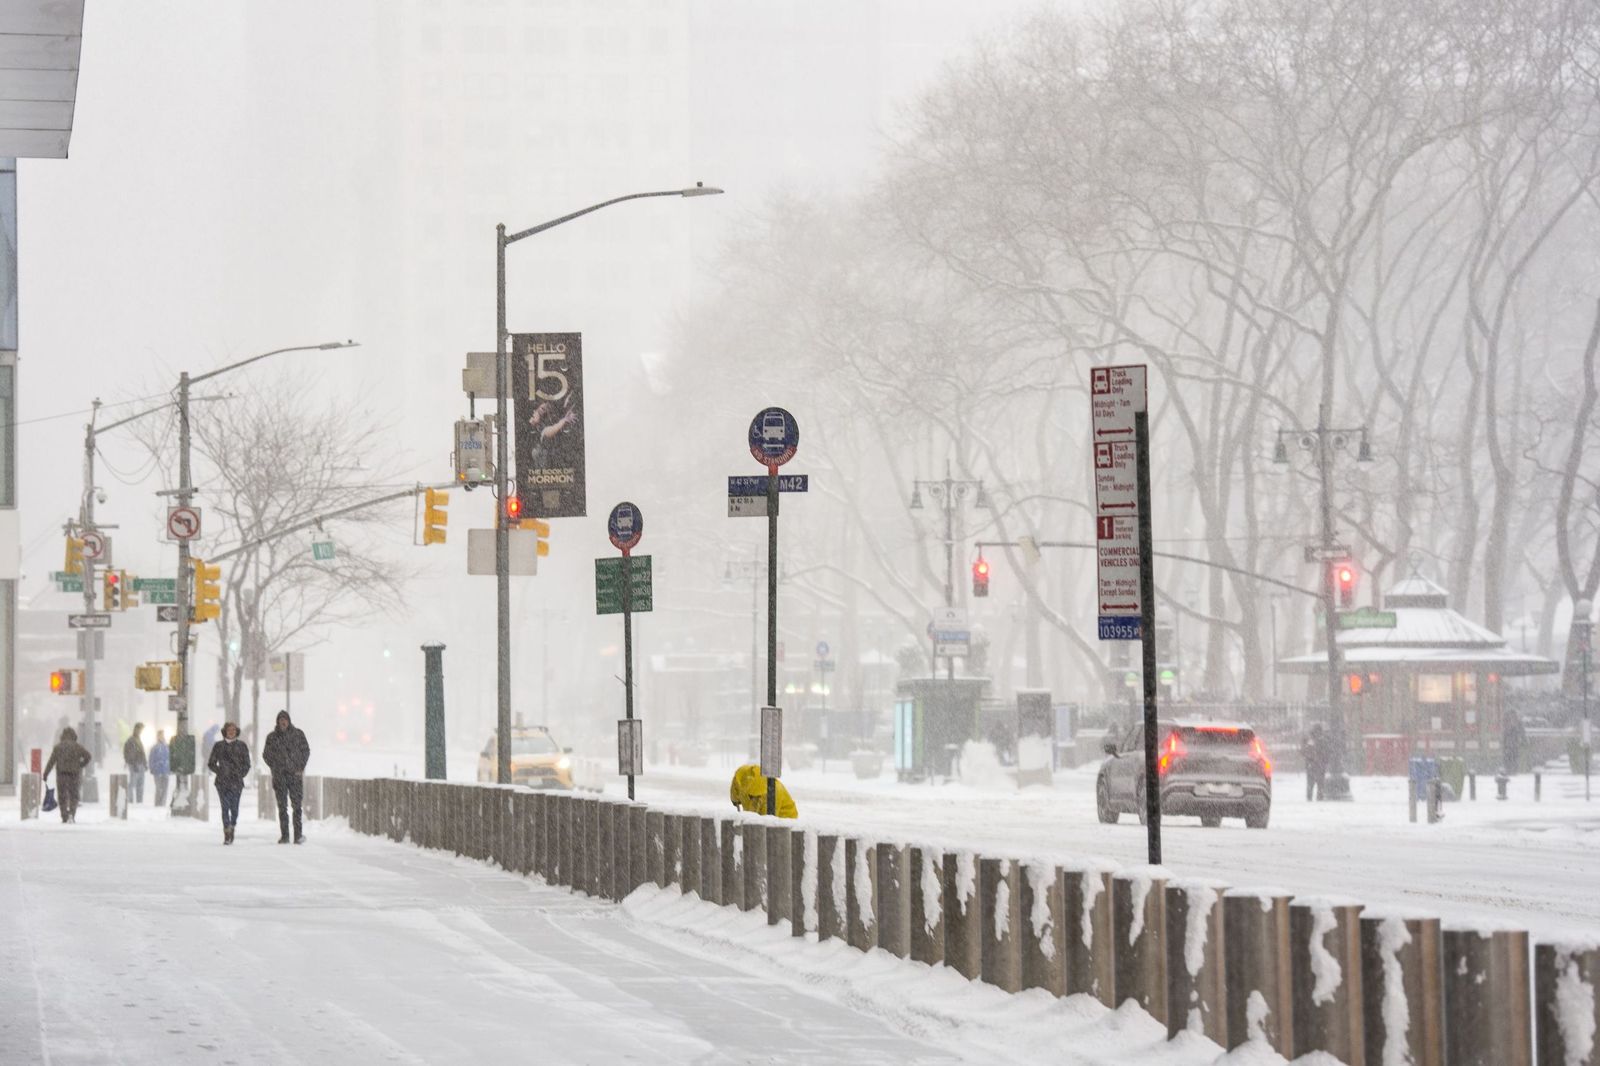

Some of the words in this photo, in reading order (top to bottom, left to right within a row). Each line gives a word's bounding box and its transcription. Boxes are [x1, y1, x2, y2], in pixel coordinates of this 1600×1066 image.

[528, 343, 566, 353] HELLO
[524, 353, 568, 401] 15
[1112, 369, 1126, 377] Truck
[1112, 378, 1133, 386] Loading
[1112, 387, 1124, 395] Only
[1095, 400, 1115, 409] Midnight
[1114, 452, 1135, 461] Loading
[1115, 461, 1126, 469] Only
[528, 474, 574, 484] MORMON
[1098, 474, 1115, 482] Sunday
[779, 477, 803, 490] M42
[1113, 482, 1135, 492] Midnight
[1102, 518, 1109, 537] 1
[1100, 547, 1140, 556] COMMERCIAL
[1100, 558, 1127, 568] VEHICLES
[1116, 578, 1136, 588] Midnight
[1101, 587, 1117, 597] Except
[1119, 587, 1136, 597] Sunday
[1100, 625, 1133, 638] 103955
